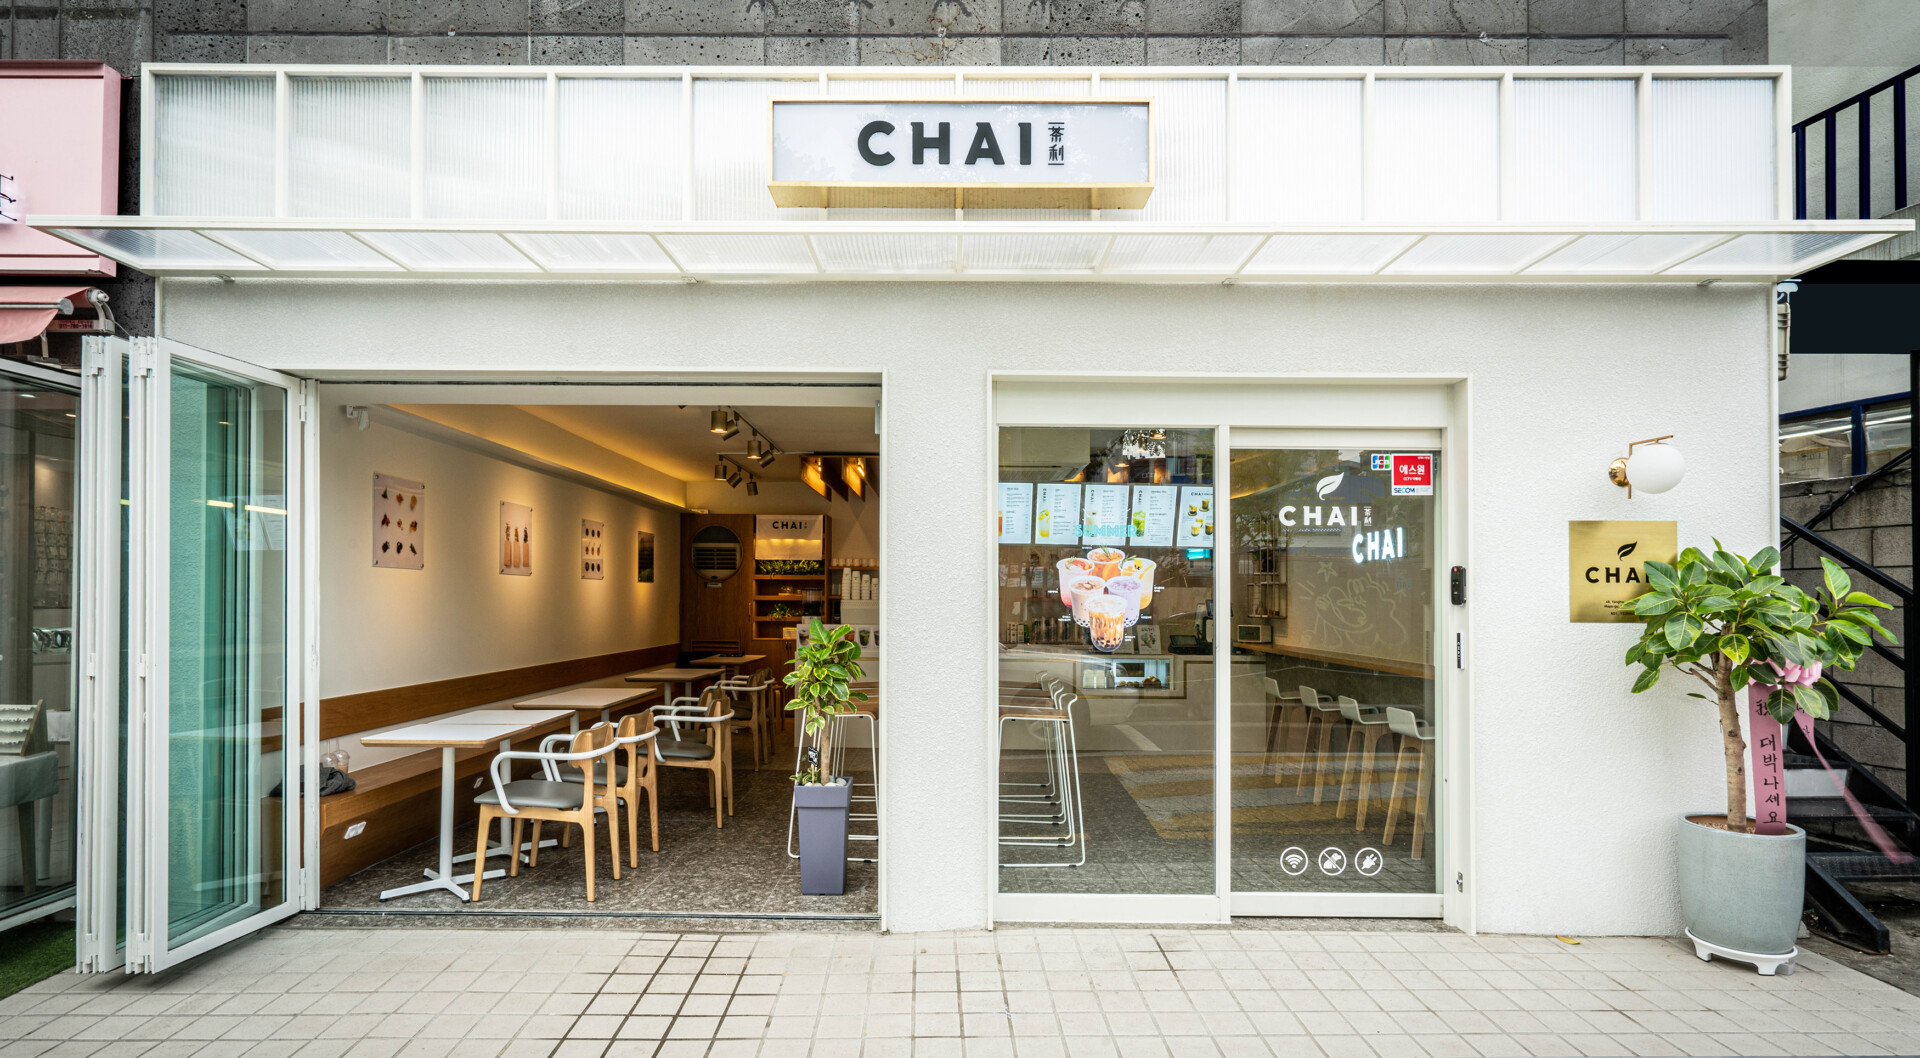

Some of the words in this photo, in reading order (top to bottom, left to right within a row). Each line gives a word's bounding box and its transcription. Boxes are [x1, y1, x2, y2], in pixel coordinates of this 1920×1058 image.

[857, 120, 1031, 166] CHAI
[1399, 464, 1425, 475] 에스원
[772, 521, 802, 530] CHAI
[1278, 505, 1358, 527] CHAI
[1075, 524, 1138, 538] SUMMER
[1352, 527, 1403, 564] CHAI
[1760, 733, 1783, 824] 대박나세요
